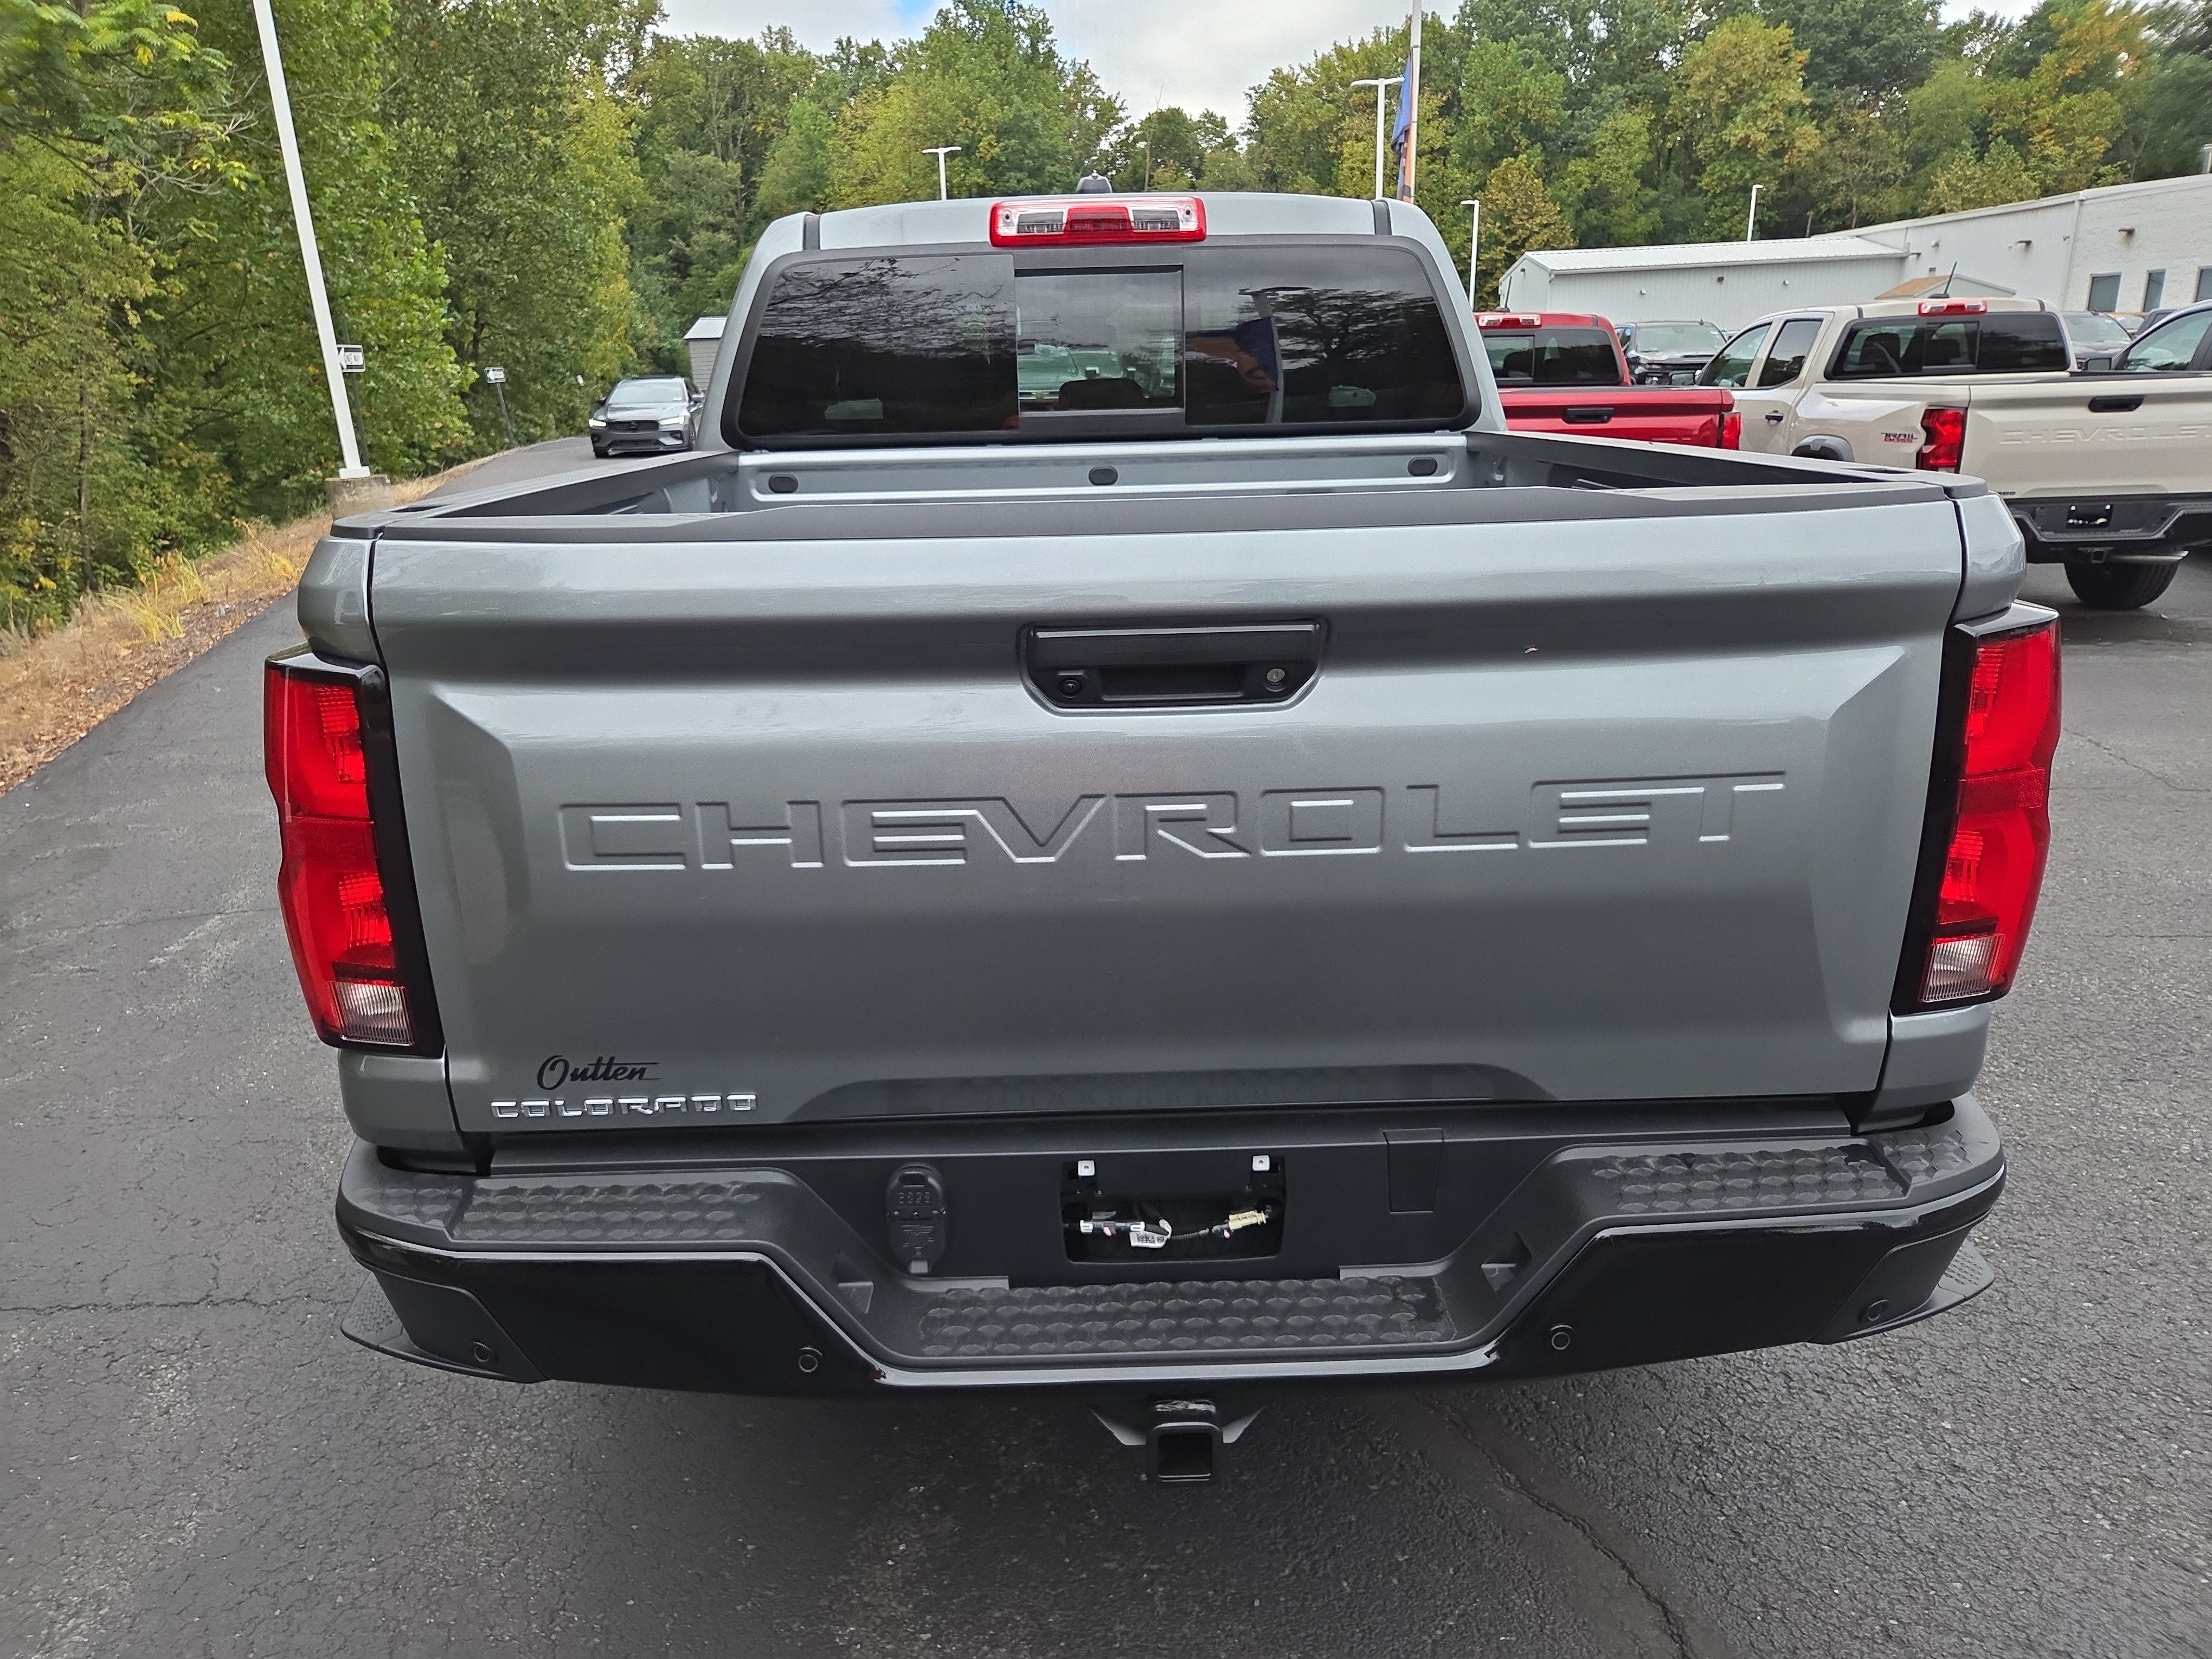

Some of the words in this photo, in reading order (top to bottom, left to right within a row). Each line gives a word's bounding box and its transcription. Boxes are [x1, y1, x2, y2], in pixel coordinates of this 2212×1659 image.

[560, 771, 1786, 870] CHEVROLET
[537, 1054, 661, 1090] Outten
[490, 1094, 757, 1118] COLORADO
